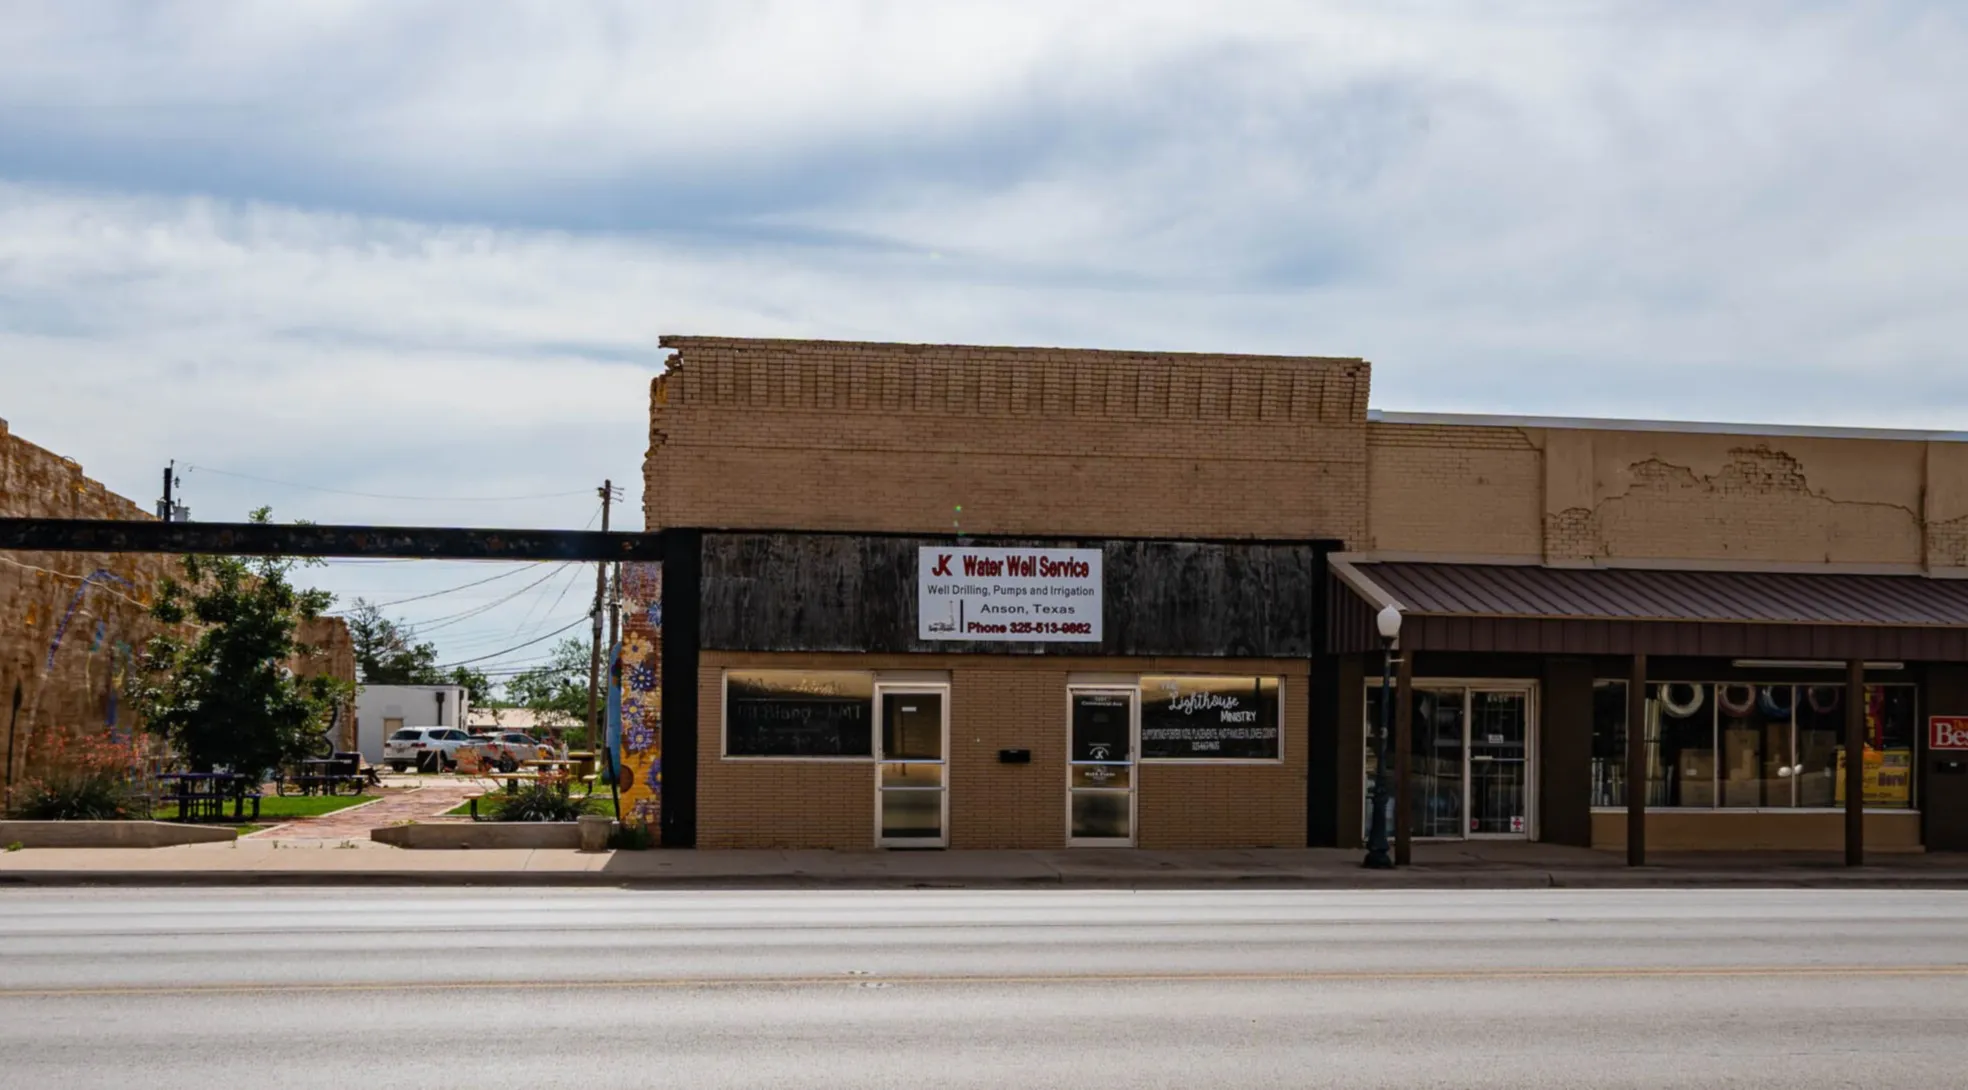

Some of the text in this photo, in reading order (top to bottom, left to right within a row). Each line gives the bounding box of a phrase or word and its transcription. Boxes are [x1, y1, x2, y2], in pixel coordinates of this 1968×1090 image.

[932, 554, 1089, 578] JK Water Well Service
[927, 584, 1095, 598] Well Drilling, Pumps and Irrigation
[980, 603, 1075, 615] Anson, Texas
[967, 622, 1007, 634] Phone
[1168, 690, 1240, 715] Lighthouse
[1220, 711, 1257, 723] MINISTRY
